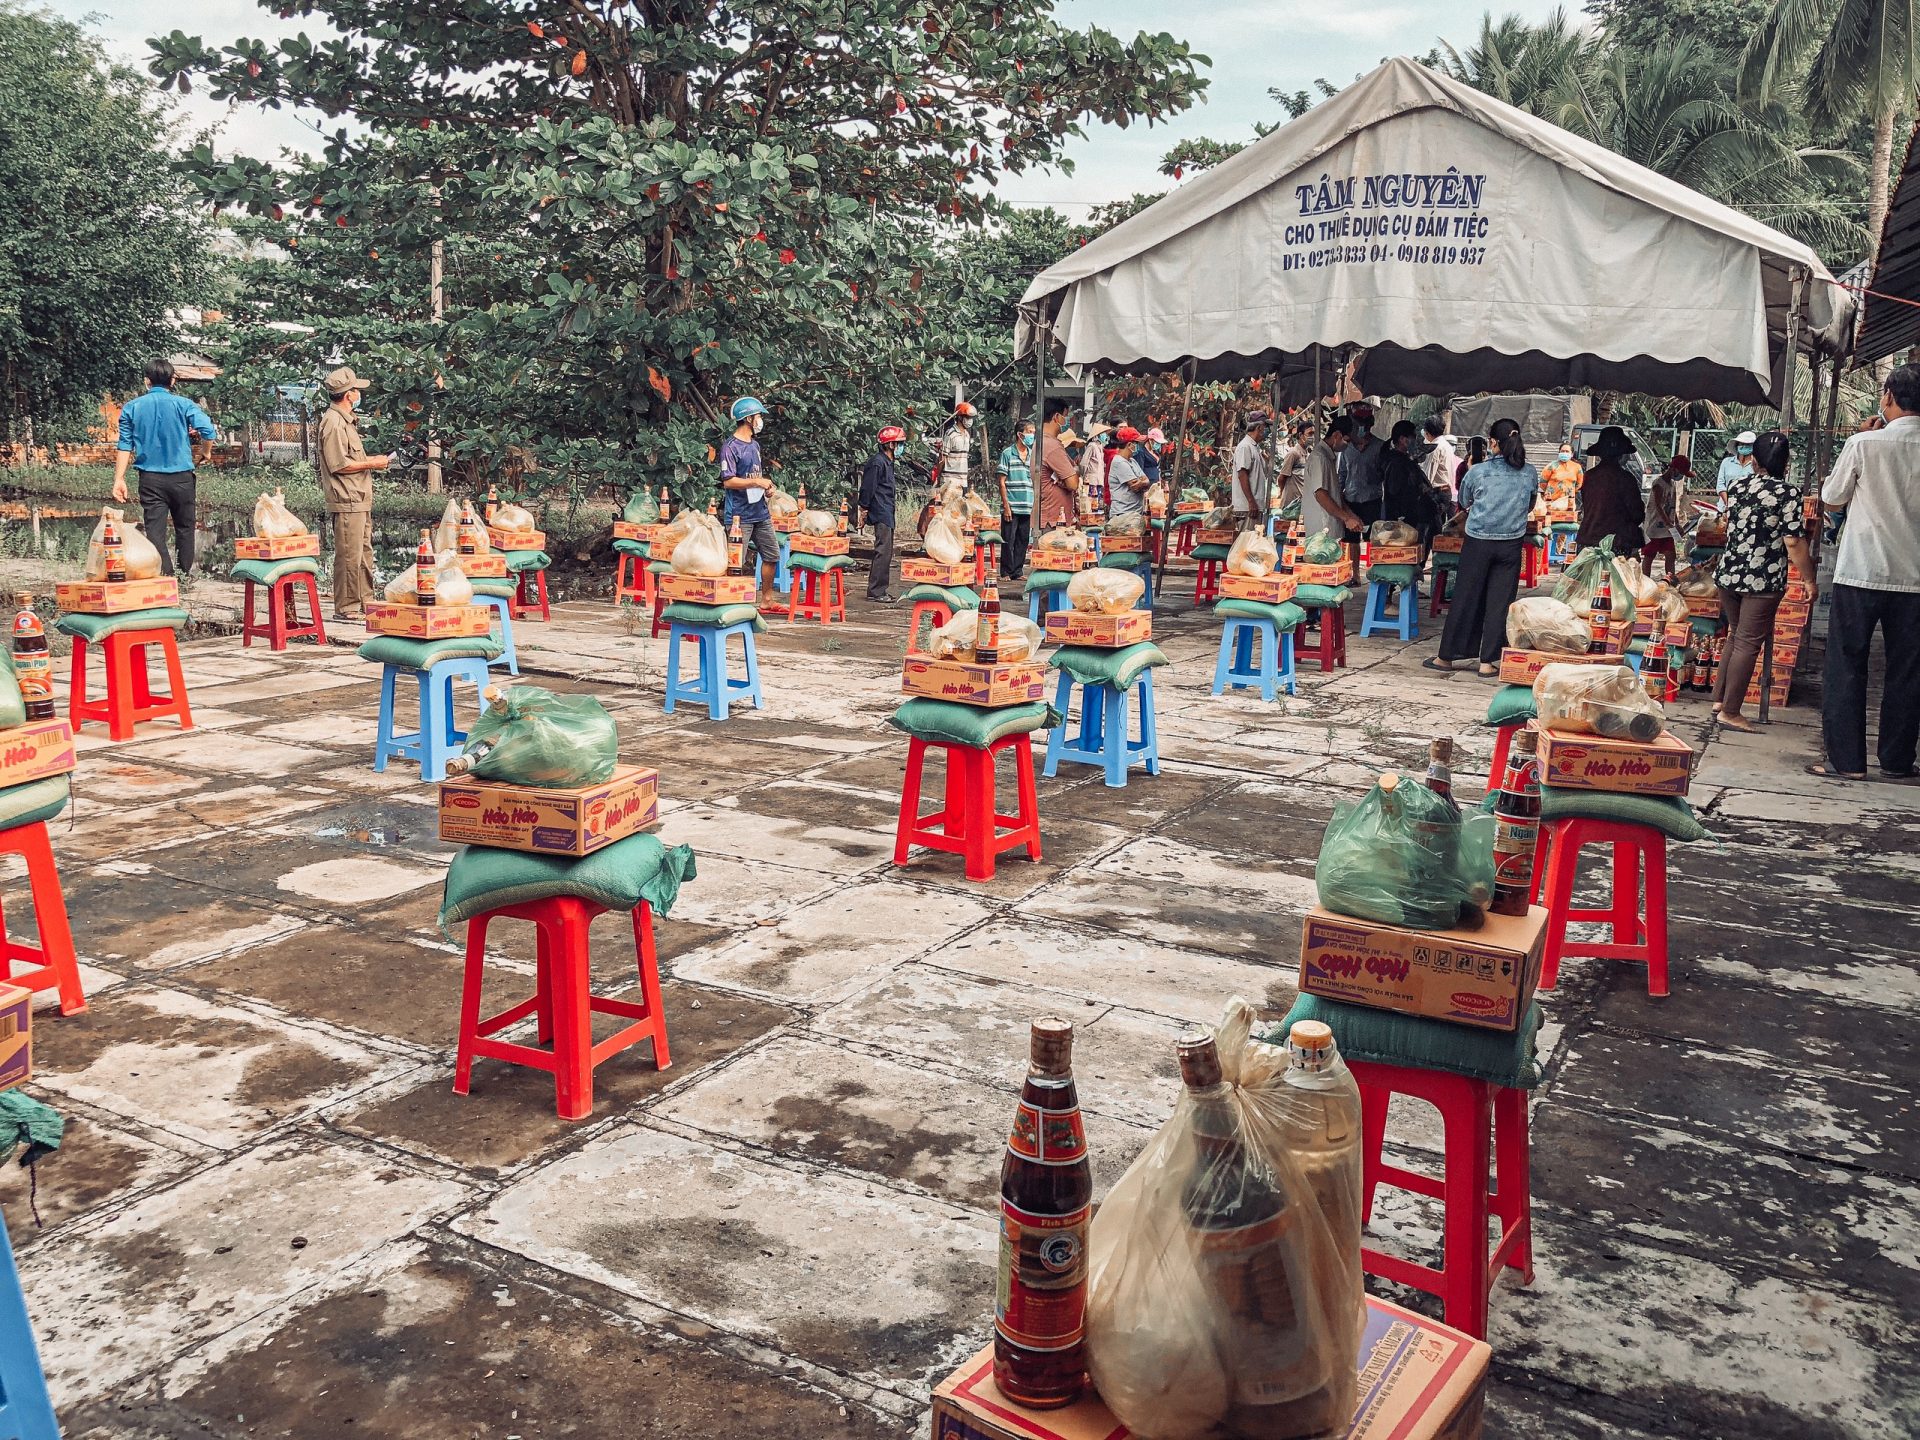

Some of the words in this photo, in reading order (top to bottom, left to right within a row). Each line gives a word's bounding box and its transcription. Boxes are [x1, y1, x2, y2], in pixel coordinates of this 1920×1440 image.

[1296, 173, 1356, 216] TÁM
[1362, 165, 1486, 208] NGUYÊN
[1285, 223, 1314, 246] CHO
[1319, 212, 1350, 241] THUÊ
[1352, 215, 1389, 242] DỤNG
[1392, 214, 1412, 242] CỤ
[1415, 210, 1449, 237] ĐÁM
[1454, 212, 1489, 244] TIỆC
[1398, 244, 1429, 264] 0918
[1432, 246, 1456, 265] 819
[1460, 246, 1486, 266] 937
[1584, 758, 1617, 776] Hảo
[1618, 757, 1652, 776] Hảo
[482, 806, 508, 825] Hảo
[510, 806, 540, 824] Hảo
[1318, 953, 1362, 979] Hảo
[1364, 955, 1410, 984] Hảo
